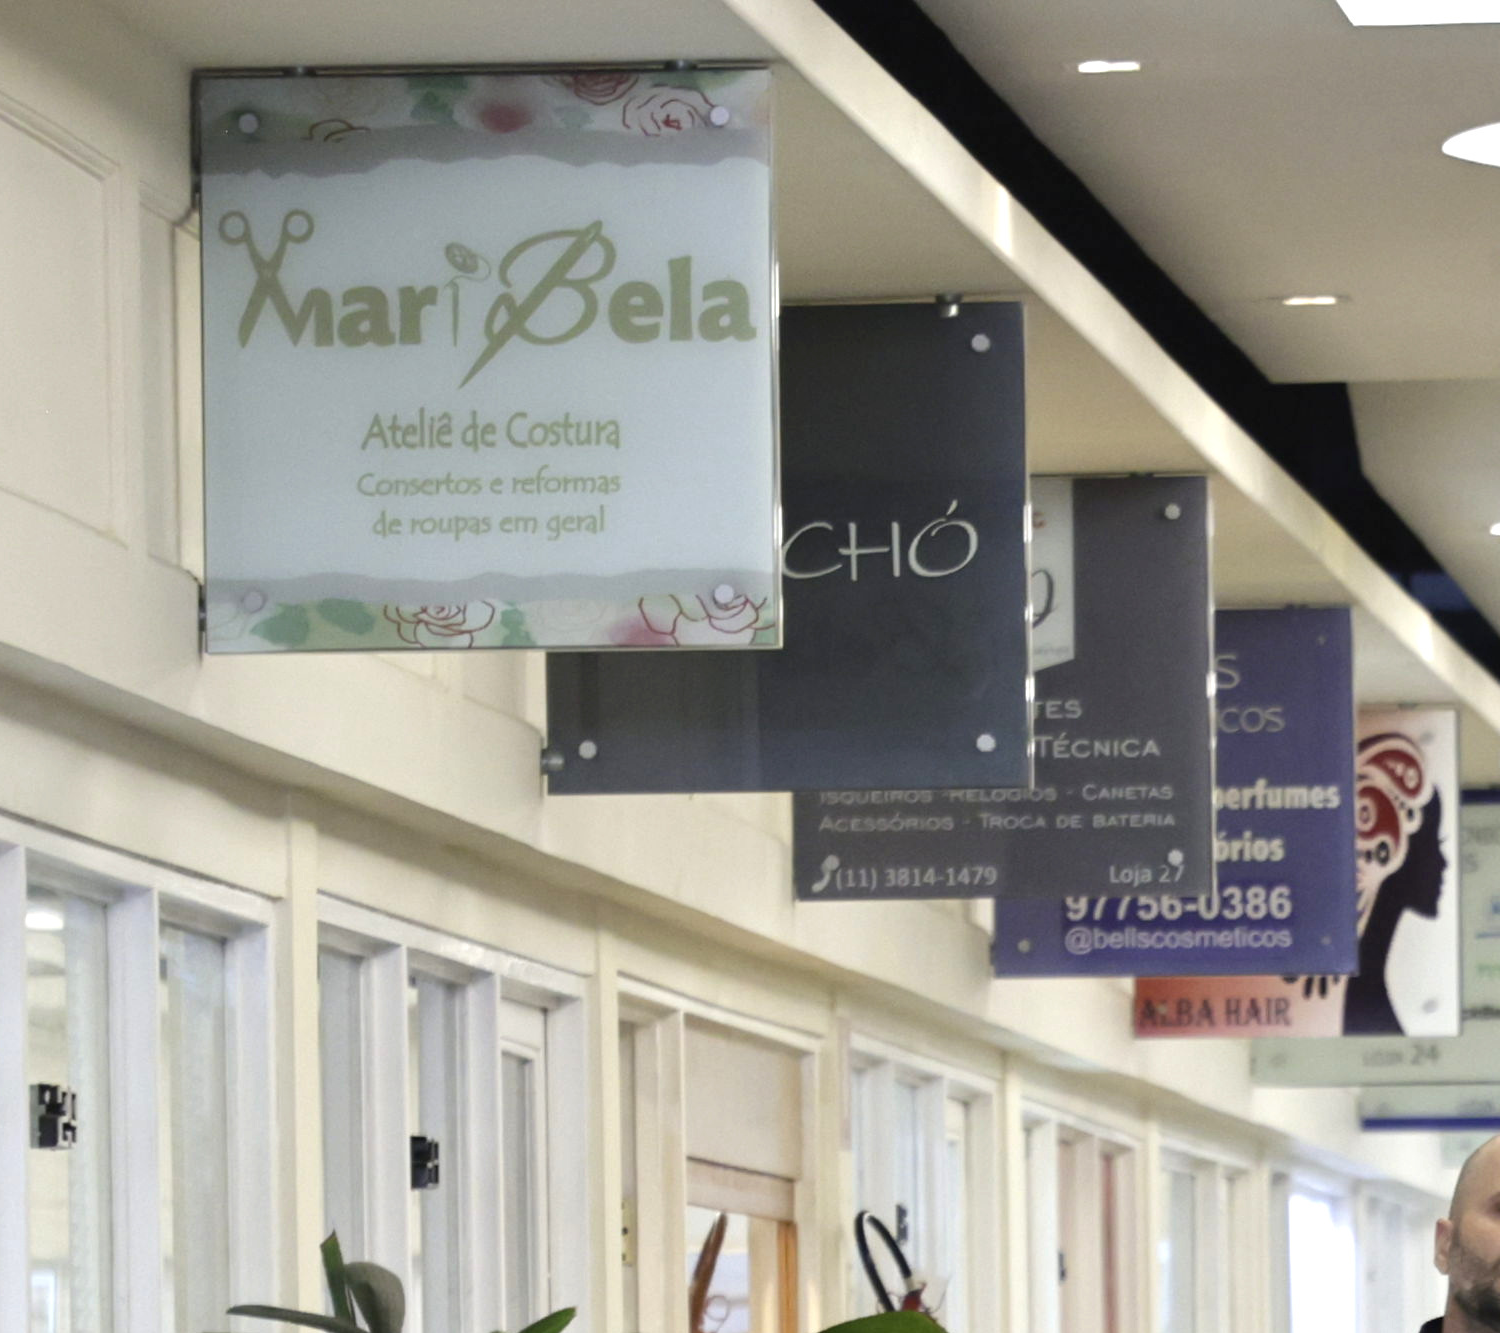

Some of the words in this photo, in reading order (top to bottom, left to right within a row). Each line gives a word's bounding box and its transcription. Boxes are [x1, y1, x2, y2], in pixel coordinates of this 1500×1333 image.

[361, 407, 453, 450] Ateliê
[461, 410, 497, 450] de
[506, 411, 620, 449] Costura
[357, 472, 482, 497] Consertos
[489, 477, 503, 494] e
[511, 464, 621, 494] reformas
[372, 510, 402, 538] de
[410, 515, 491, 541] roupas
[499, 516, 537, 534] em
[546, 504, 605, 541] geral
[1034, 732, 1161, 758] TÉCNICA
[835, 867, 878, 890] (11)
[884, 865, 998, 887] 3814-1479
[1109, 865, 1153, 887] Loja
[1224, 998, 1293, 1026] HAIR
